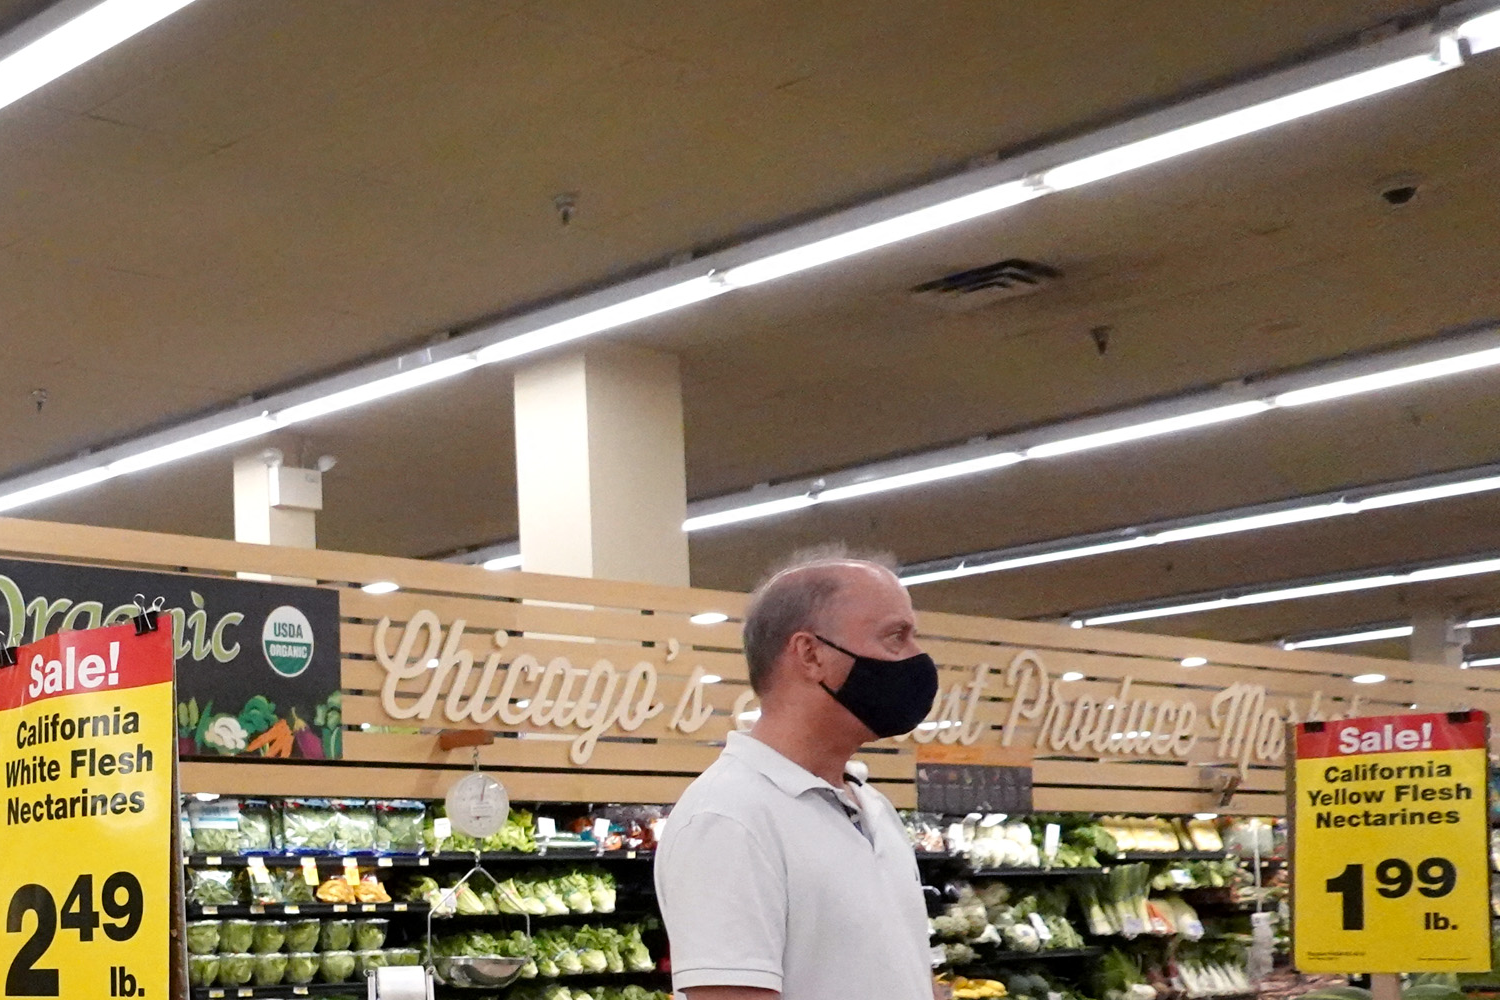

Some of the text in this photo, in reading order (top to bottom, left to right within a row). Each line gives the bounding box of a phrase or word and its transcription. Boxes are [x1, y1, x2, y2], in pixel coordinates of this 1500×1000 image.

[273, 622, 304, 639] USDA
[269, 644, 308, 660] ORGANIC
[28, 640, 121, 699] Sale!
[374, 609, 714, 765] Chicago's
[1001, 648, 1199, 758] Produce
[16, 706, 140, 750] California
[1338, 722, 1433, 755] Sale!
[5, 743, 154, 789] White Flesh
[1324, 760, 1453, 784] California
[7, 788, 146, 826] Nectarines
[1307, 783, 1473, 808] Yellow Flesh
[1316, 809, 1461, 830] Nectarines
[1424, 912, 1459, 931] lb.
[110, 966, 146, 998] lb.
